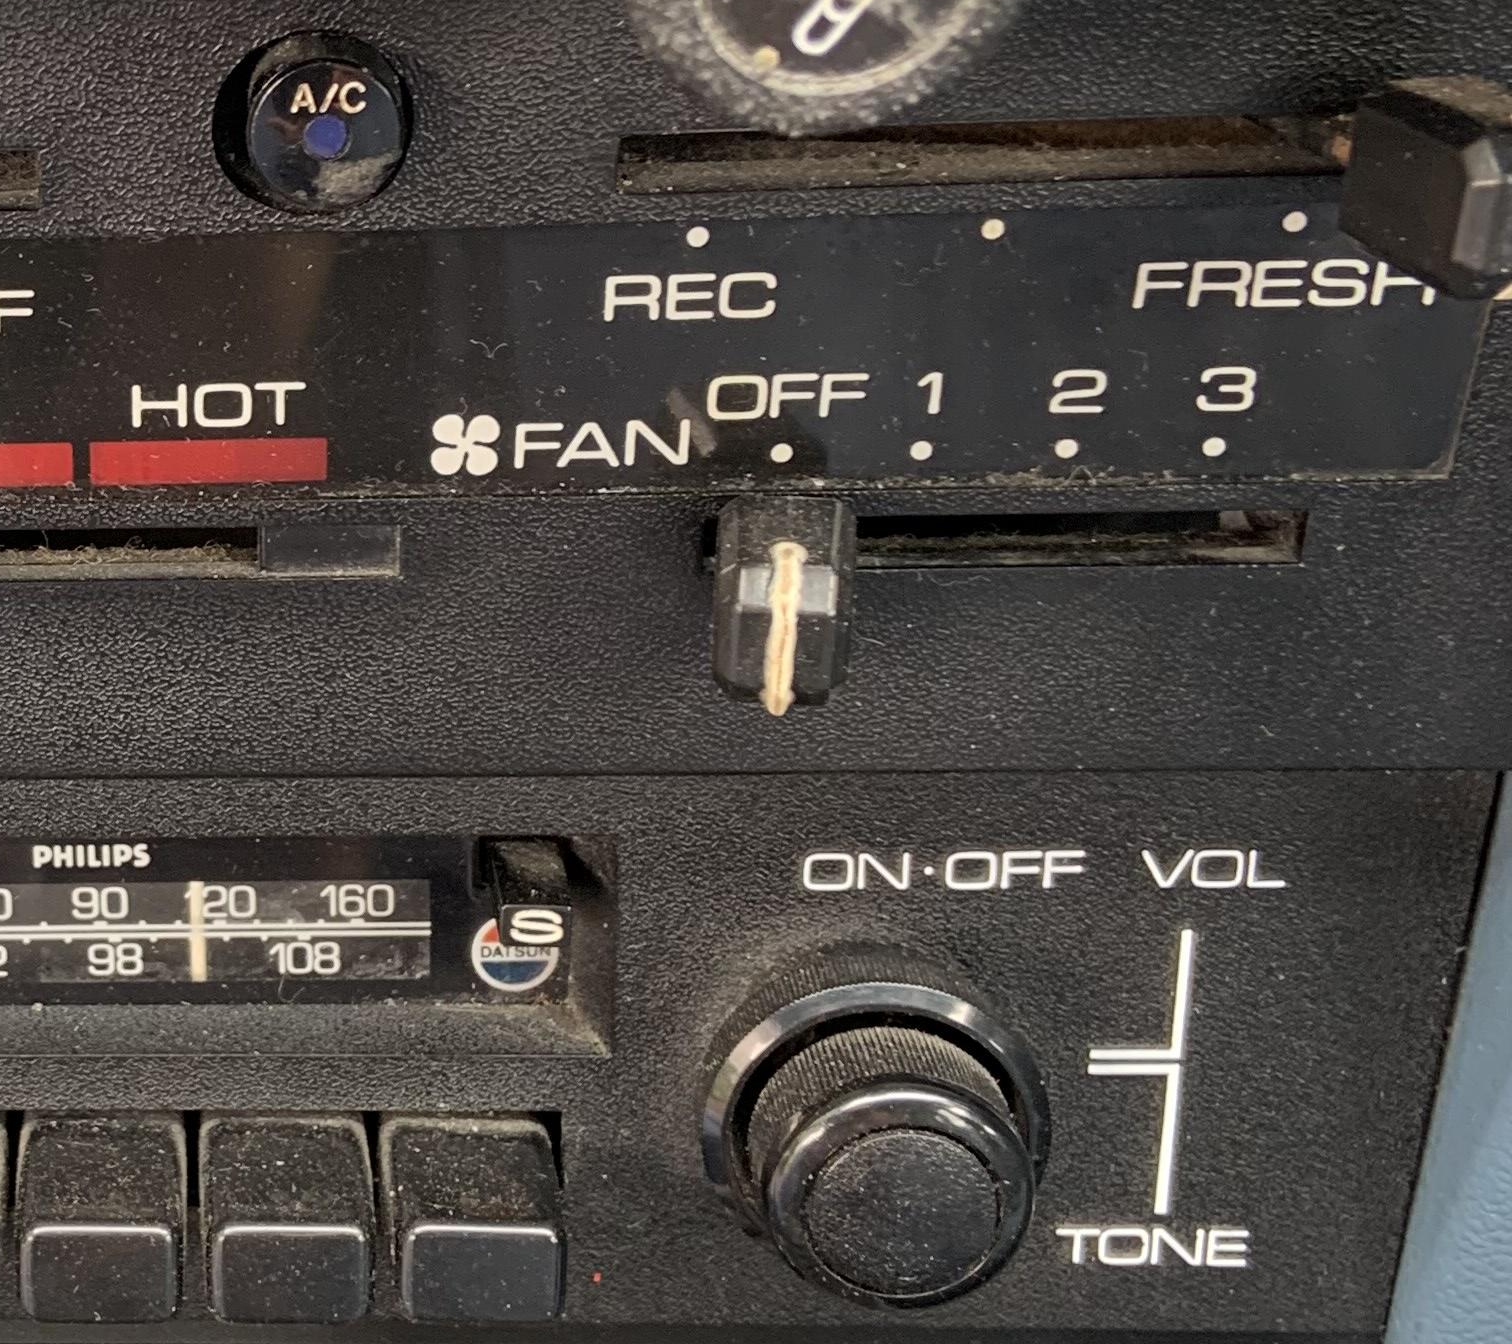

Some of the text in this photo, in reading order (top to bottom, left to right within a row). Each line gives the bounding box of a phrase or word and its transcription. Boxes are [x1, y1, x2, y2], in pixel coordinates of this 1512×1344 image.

[290, 81, 368, 115] A/C
[603, 272, 778, 321] REC
[1131, 258, 1437, 310] FRESH
[129, 381, 306, 429] HOT
[706, 366, 1257, 420] OFF 1 2 3
[513, 419, 691, 468] FAN
[32, 844, 151, 868] PHILIPS
[1142, 849, 1286, 889] VOL
[71, 887, 129, 920] 90
[320, 885, 394, 917] 160
[510, 909, 564, 944] S
[87, 944, 144, 976] 98
[269, 942, 342, 975] 108
[1055, 1227, 1249, 1268] TONE
